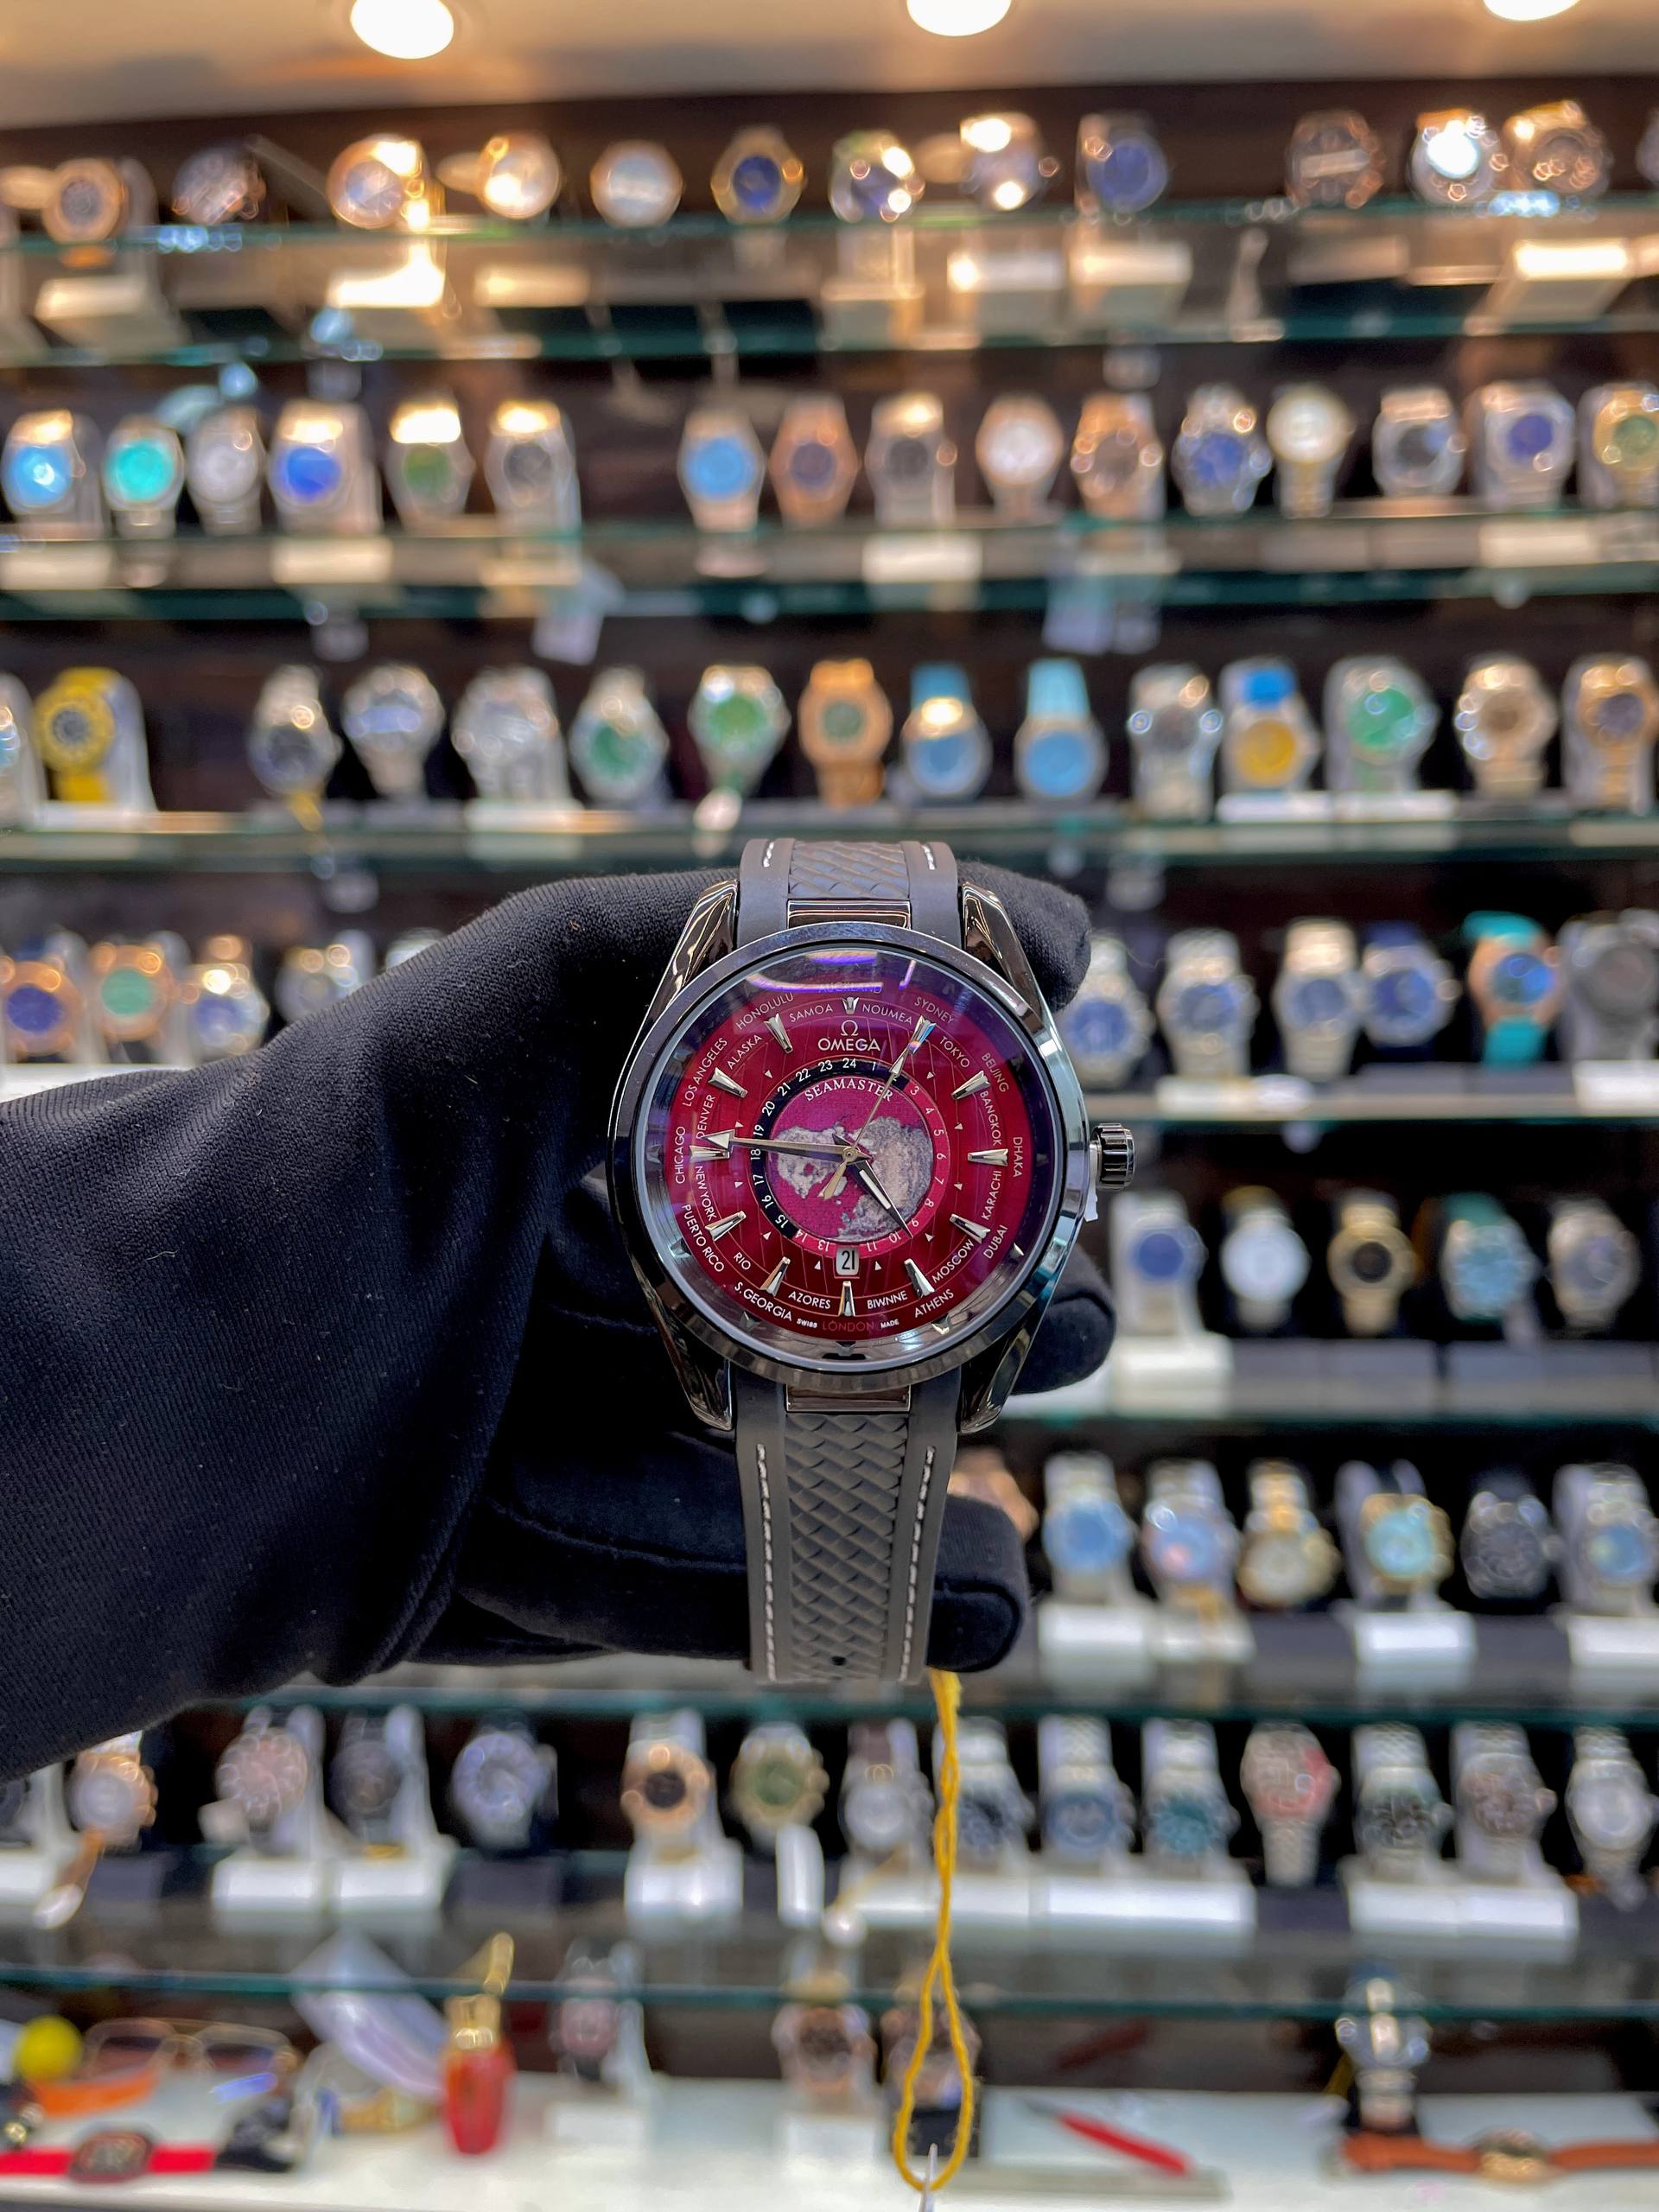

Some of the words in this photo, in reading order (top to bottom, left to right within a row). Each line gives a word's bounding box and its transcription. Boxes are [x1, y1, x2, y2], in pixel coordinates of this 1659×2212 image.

[735, 992, 794, 1030] HONOLULU
[789, 1003, 833, 1022] SAMOA
[862, 1004, 912, 1025] NOUMEA
[914, 996, 955, 1024] SYDNEY
[727, 1034, 762, 1070] ALASKA
[817, 1038, 880, 1052] OMEGA
[939, 1036, 970, 1068] TOKYO
[682, 1084, 698, 1107] LOS
[692, 1037, 728, 1085] ANGELES
[981, 1052, 1009, 1092] BEIJING
[762, 1101, 775, 1116] 20
[778, 1082, 791, 1096] 21
[795, 1068, 811, 1083] 22
[817, 1059, 833, 1071] 23
[842, 1058, 856, 1069] 24
[804, 1077, 893, 1102] SEAMASTER
[696, 1093, 716, 1141] DENVER
[753, 1124, 765, 1137] 19
[979, 1090, 1002, 1147] BANGKOK
[674, 1126, 686, 1185] CHICAGO
[750, 1148, 761, 1161] 18
[1013, 1136, 1023, 1179] DHAKA
[695, 1166, 708, 1191] NEW
[752, 1173, 765, 1186] 17
[700, 1192, 718, 1222] YORK
[761, 1193, 774, 1210] 16
[981, 1170, 1002, 1221] KARACHI
[774, 1213, 789, 1230] 15
[681, 1204, 707, 1247] PUERTO
[702, 1246, 725, 1273] RICO
[795, 1229, 809, 1243] 14
[817, 1239, 830, 1252] 13
[982, 1224, 1008, 1259] DUBAI
[733, 1252, 751, 1270] RIO
[841, 1249, 855, 1270] 21
[931, 1239, 975, 1284] MOSCOW
[743, 1287, 793, 1322] GEORGIA
[788, 1290, 831, 1310] AZORES
[914, 1288, 955, 1319] ATHENS
[822, 1320, 875, 1332] LONDON
[880, 1319, 899, 1329] MADE
